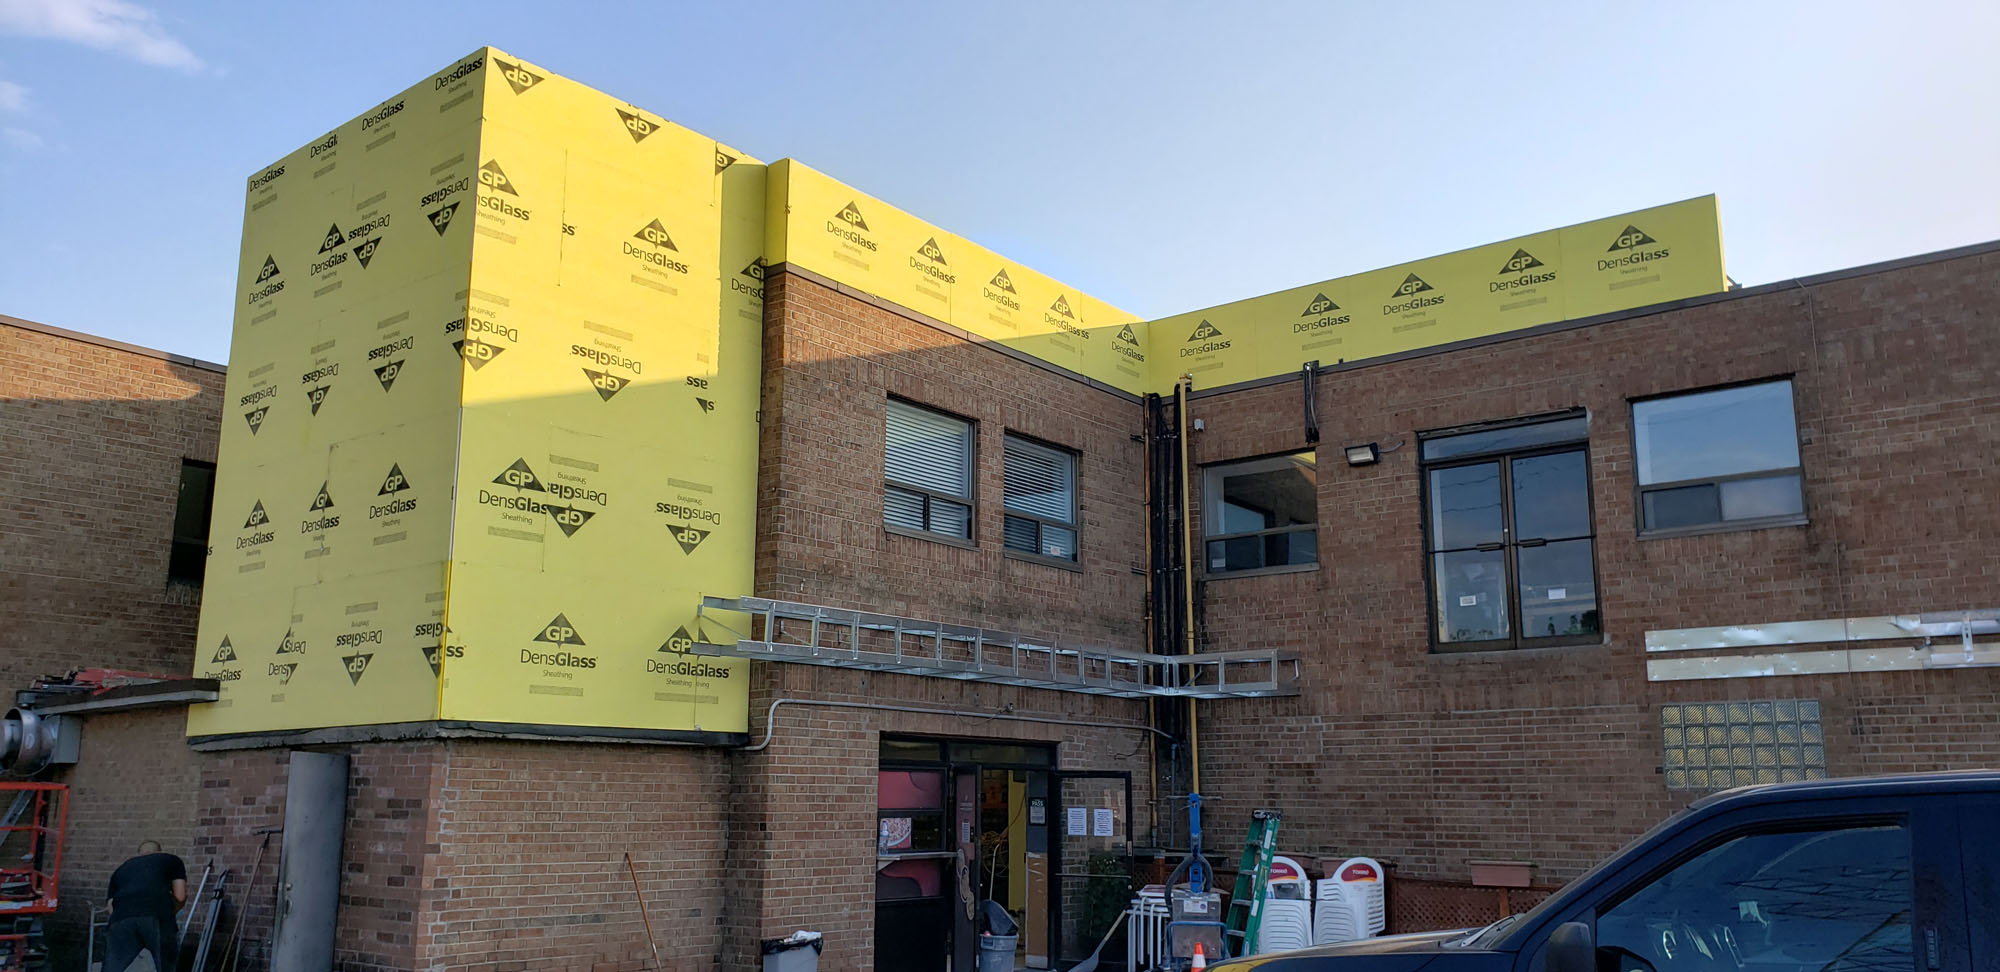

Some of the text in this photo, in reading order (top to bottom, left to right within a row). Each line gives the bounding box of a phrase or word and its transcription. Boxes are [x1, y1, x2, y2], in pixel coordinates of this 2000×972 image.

[435, 57, 483, 91] DensGlass
[505, 67, 532, 87] GP
[362, 100, 404, 131] DensGlass
[627, 116, 650, 134] GP
[250, 165, 285, 192] DensGlass
[479, 171, 506, 190] GP
[421, 176, 469, 207] DensGlass
[433, 204, 453, 226] GP
[843, 209, 861, 225] GP
[348, 214, 390, 241] DensGlass
[644, 227, 668, 244] GP
[827, 221, 877, 251] DensGlass
[324, 233, 340, 250] GP
[358, 241, 375, 257] GP
[1617, 233, 1643, 247] GP
[623, 242, 688, 274] DensGlass
[924, 245, 940, 260] GP
[1597, 248, 1669, 271] DensGlass
[261, 263, 275, 278] GP
[910, 256, 955, 284] DensGlass
[1508, 256, 1532, 270] GP
[995, 276, 1010, 289] GP
[1400, 281, 1423, 294] GP
[1489, 271, 1556, 292] DensGlass
[249, 280, 285, 304] DensGlass
[1056, 301, 1069, 314] GP
[1310, 301, 1331, 314] GP
[1383, 294, 1444, 315] DensGlass
[1045, 312, 1080, 337] DensGlass
[1195, 326, 1213, 338] GP
[1293, 314, 1350, 333] DensGlass
[1121, 330, 1134, 343] GP
[368, 336, 413, 360] DensGlass
[1112, 340, 1144, 362] DensGlass
[1180, 339, 1231, 358] DensGlass
[572, 344, 641, 374] DensGlass
[380, 364, 398, 382] GP
[596, 375, 620, 391] GP
[240, 385, 277, 406] DensGlass
[250, 410, 264, 425] GP
[385, 475, 403, 491] GP
[505, 470, 533, 486] GP
[250, 510, 263, 524] GP
[369, 498, 417, 519] DensGlass
[657, 502, 721, 525] DensGlass
[502, 513, 533, 525] Sheathing
[557, 510, 583, 526] GP
[236, 531, 274, 550] DensGlass
[677, 530, 700, 544] GP
[336, 629, 382, 648] DensGlass
[546, 625, 573, 642] GP
[217, 646, 231, 660] GP
[669, 638, 692, 653] GP
[350, 657, 365, 672] GP
[521, 649, 596, 668] DensGlass
[543, 669, 573, 680] Sheathing
